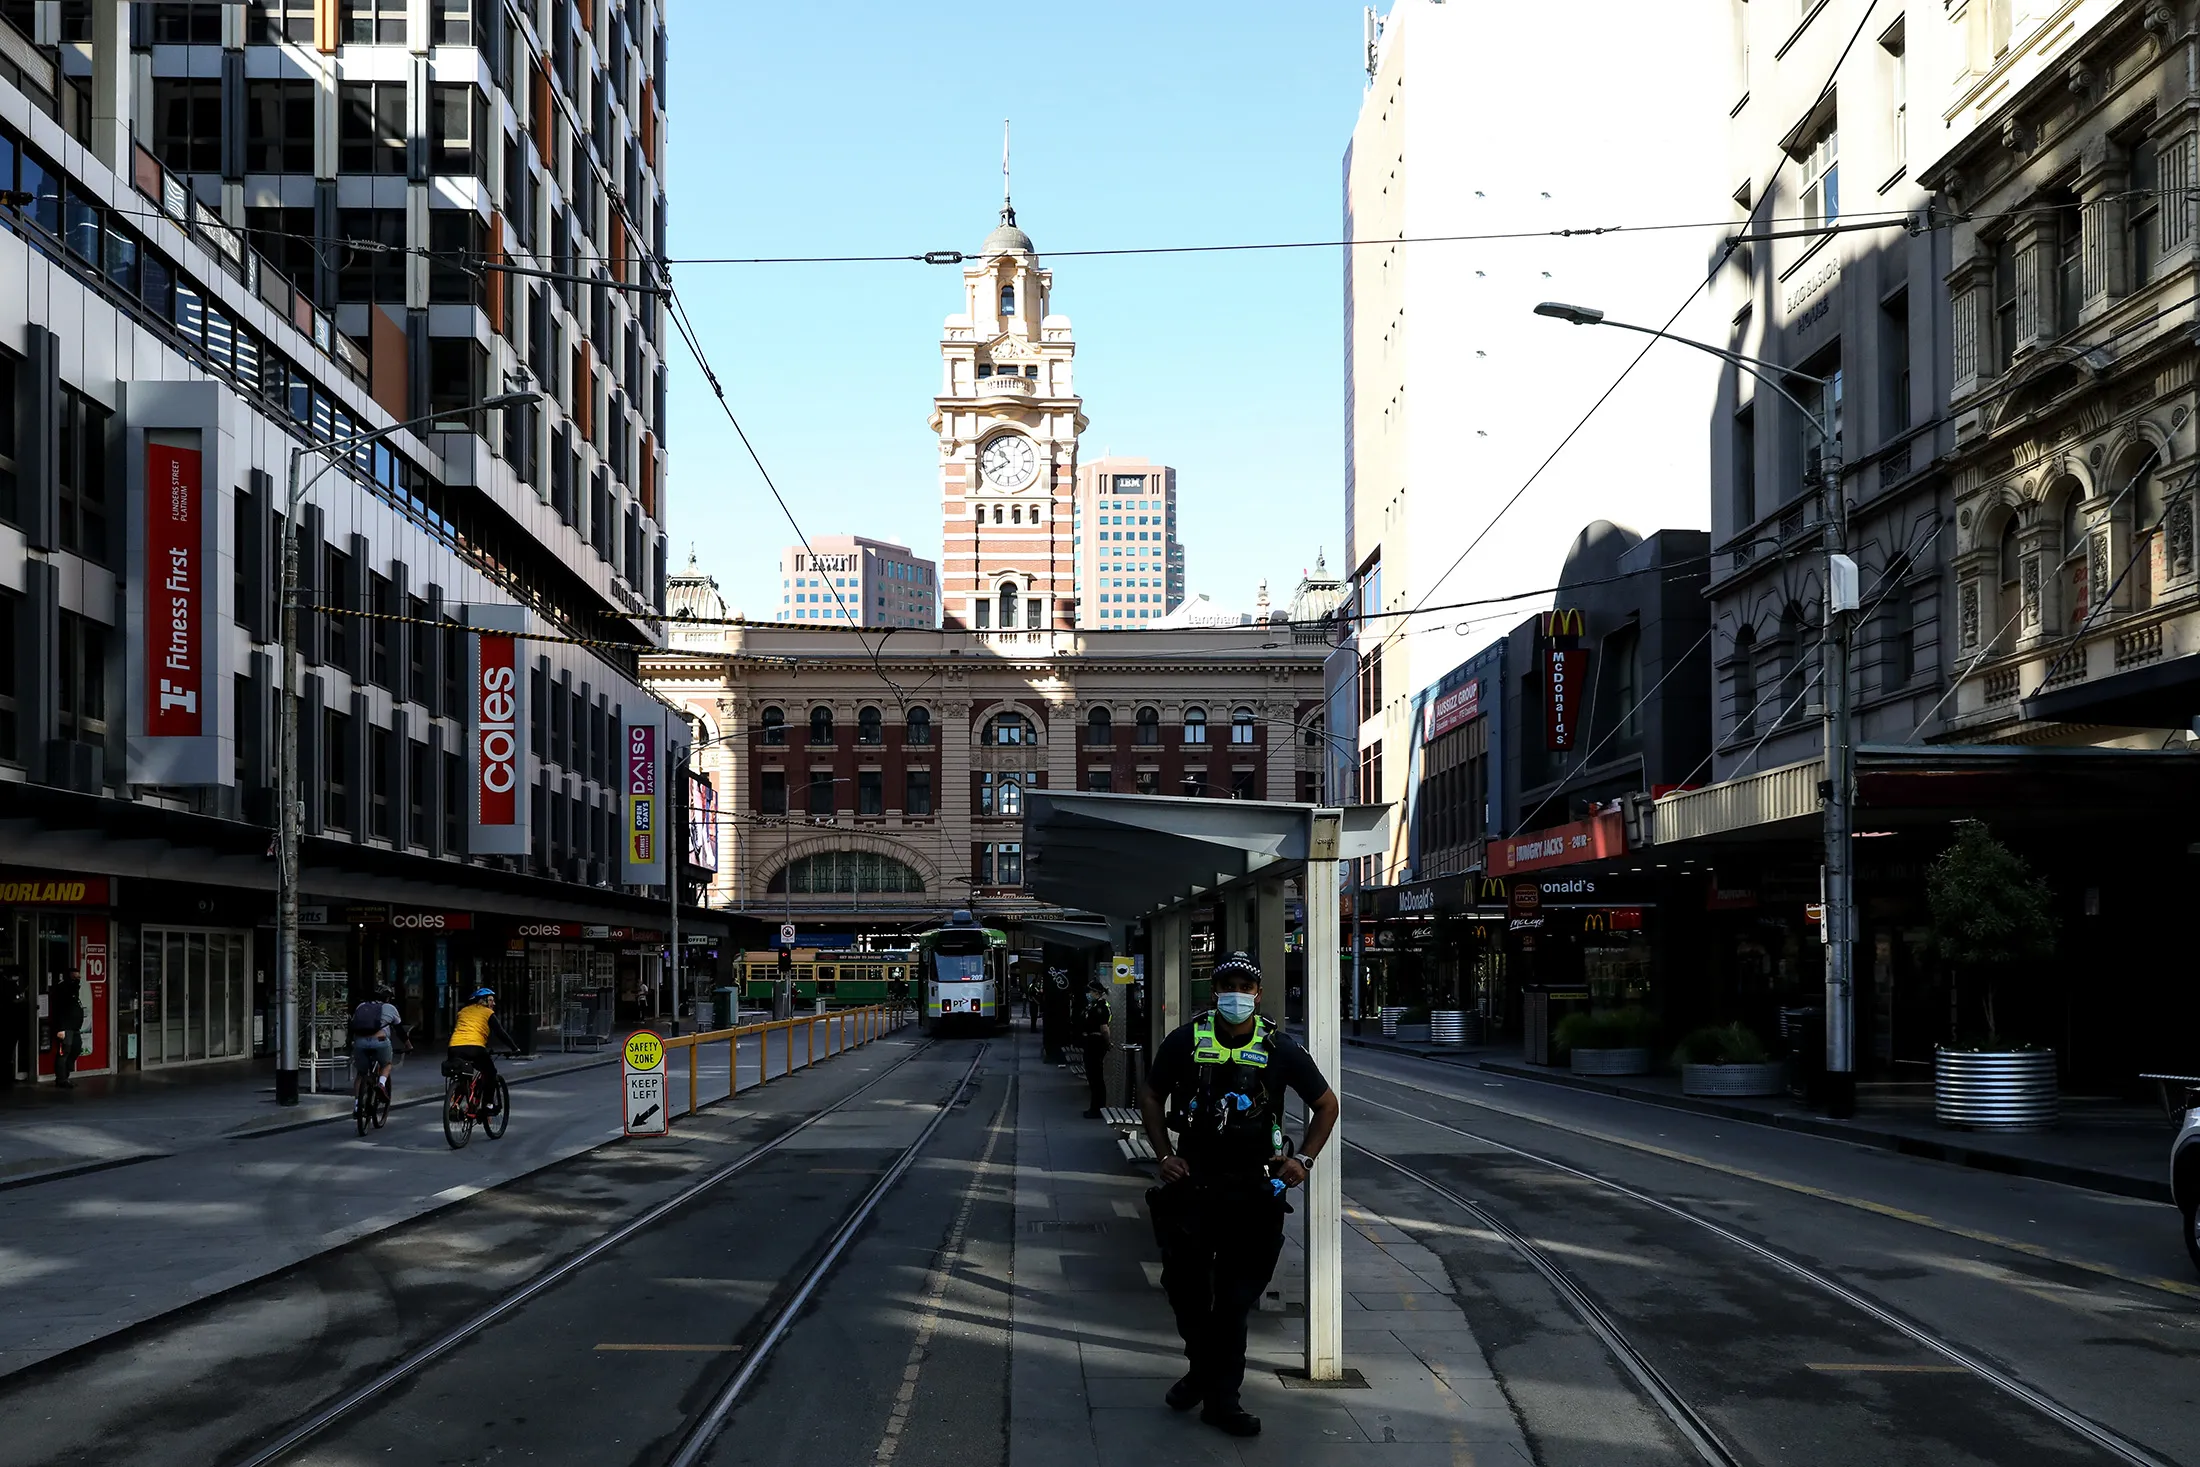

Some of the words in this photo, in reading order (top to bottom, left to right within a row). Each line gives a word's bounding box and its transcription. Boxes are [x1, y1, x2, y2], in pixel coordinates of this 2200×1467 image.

[171, 460, 180, 485] STREET
[1119, 478, 1140, 487] IBM
[171, 486, 180, 521] FLINDERS
[180, 485, 188, 522] PLATINUM
[166, 547, 190, 592] First
[166, 597, 190, 670] Fitness
[1458, 682, 1478, 705] GROUP
[480, 666, 516, 793] coles
[632, 727, 646, 794] DAISO
[1516, 841, 1543, 862] HUNGRY
[1541, 880, 1595, 893] onald's
[1399, 887, 1434, 911] McDonald's
[298, 910, 322, 922] atts
[393, 913, 445, 928] coles
[518, 924, 561, 936] coles
[629, 1042, 659, 1053] SAFETY
[1242, 1051, 1266, 1061] Police
[634, 1054, 655, 1064] ZONE
[631, 1079, 658, 1088] KEEP
[632, 1090, 657, 1099] LEFT
